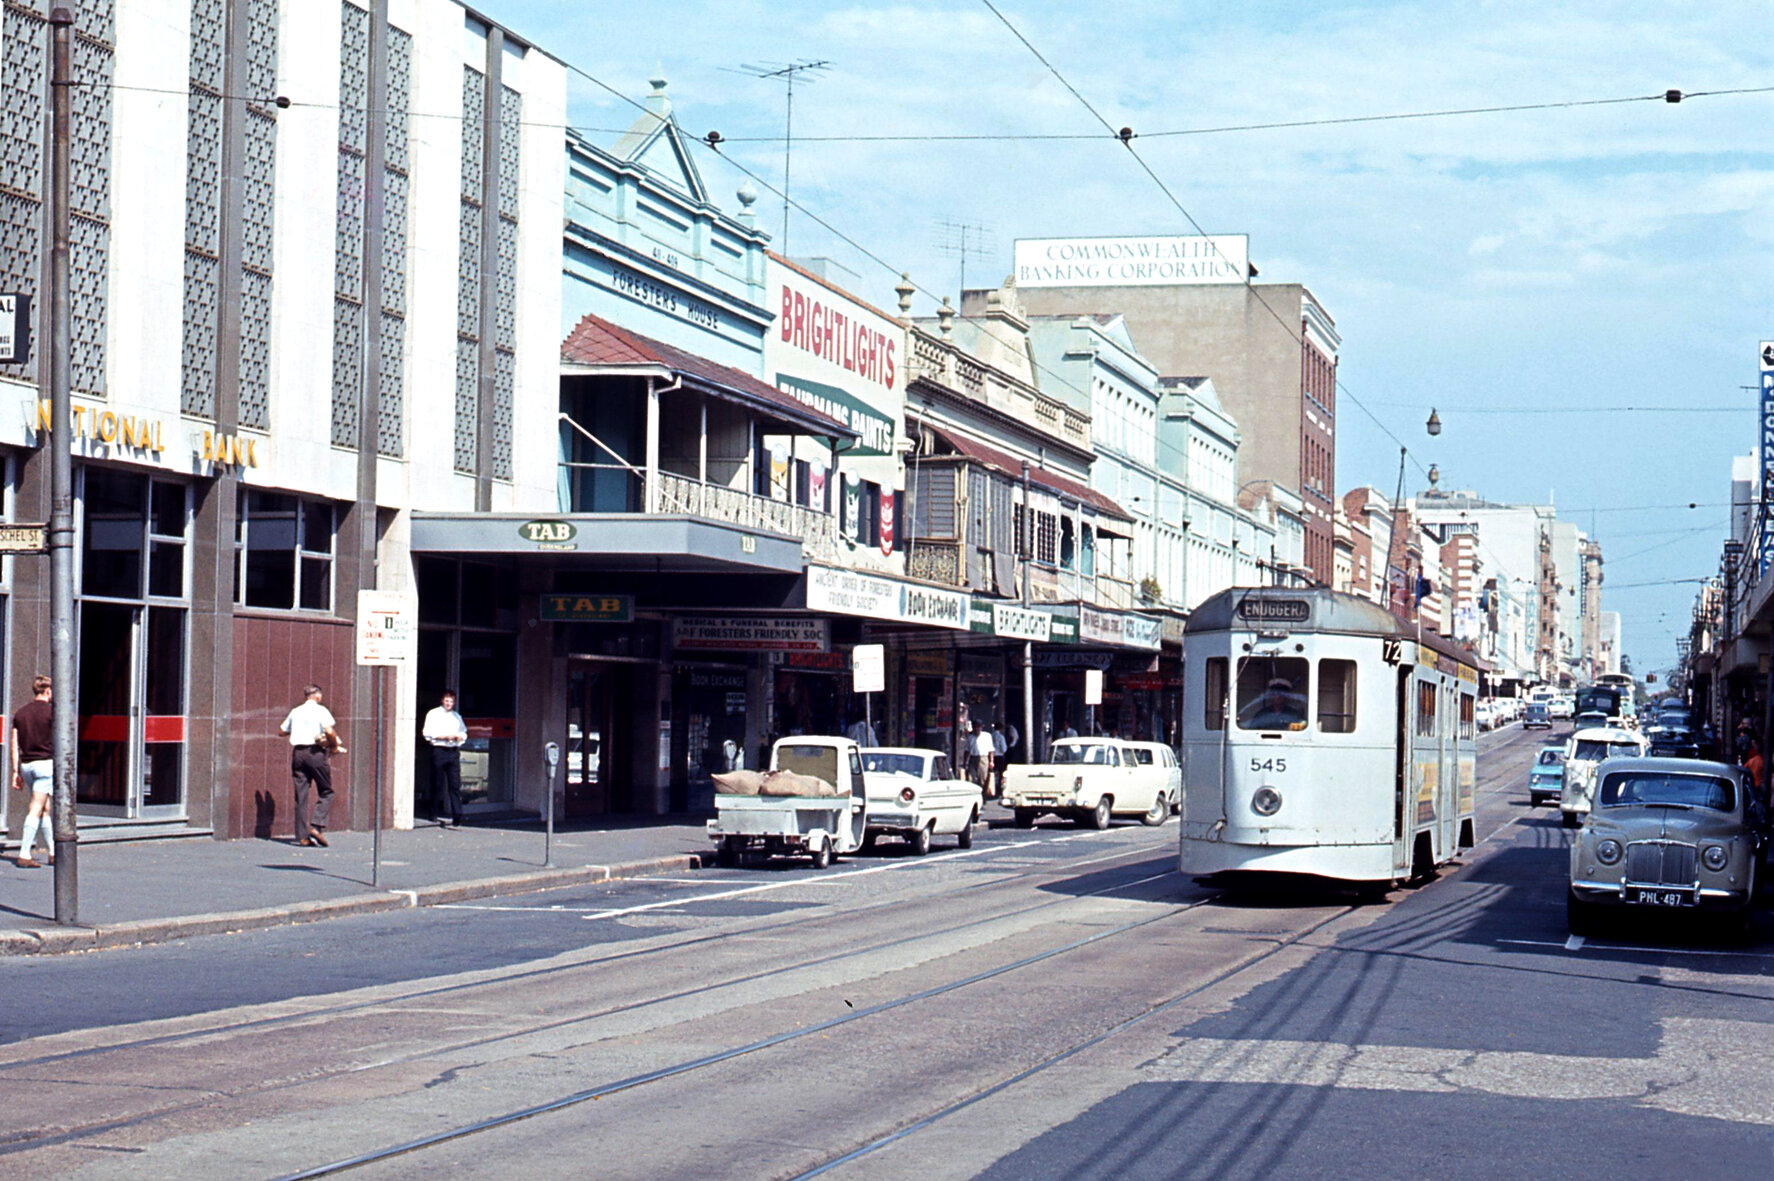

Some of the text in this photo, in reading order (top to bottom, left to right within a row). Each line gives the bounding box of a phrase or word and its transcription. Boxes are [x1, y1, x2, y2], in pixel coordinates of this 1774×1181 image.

[1047, 242, 1216, 260] COMMONWEALTH
[1020, 261, 1241, 281] BANKING CORPORATION
[687, 300, 718, 329] HOUSE
[781, 284, 896, 390] BRIGHTLIGHTS
[36, 398, 258, 468] NTIONAL BANK
[851, 409, 891, 454] PAINTS
[528, 523, 570, 541] TAB
[550, 597, 621, 612] TAB
[774, 620, 815, 628] BENEFITS
[999, 610, 1046, 636] BRIGHTLIGHTS
[699, 628, 753, 639] FORESTERS
[754, 629, 799, 640] FRIENDLY
[803, 630, 823, 640] SOC
[1384, 640, 1400, 660] 72
[711, 673, 745, 688] EXCHANGE
[1250, 758, 1286, 772] 545
